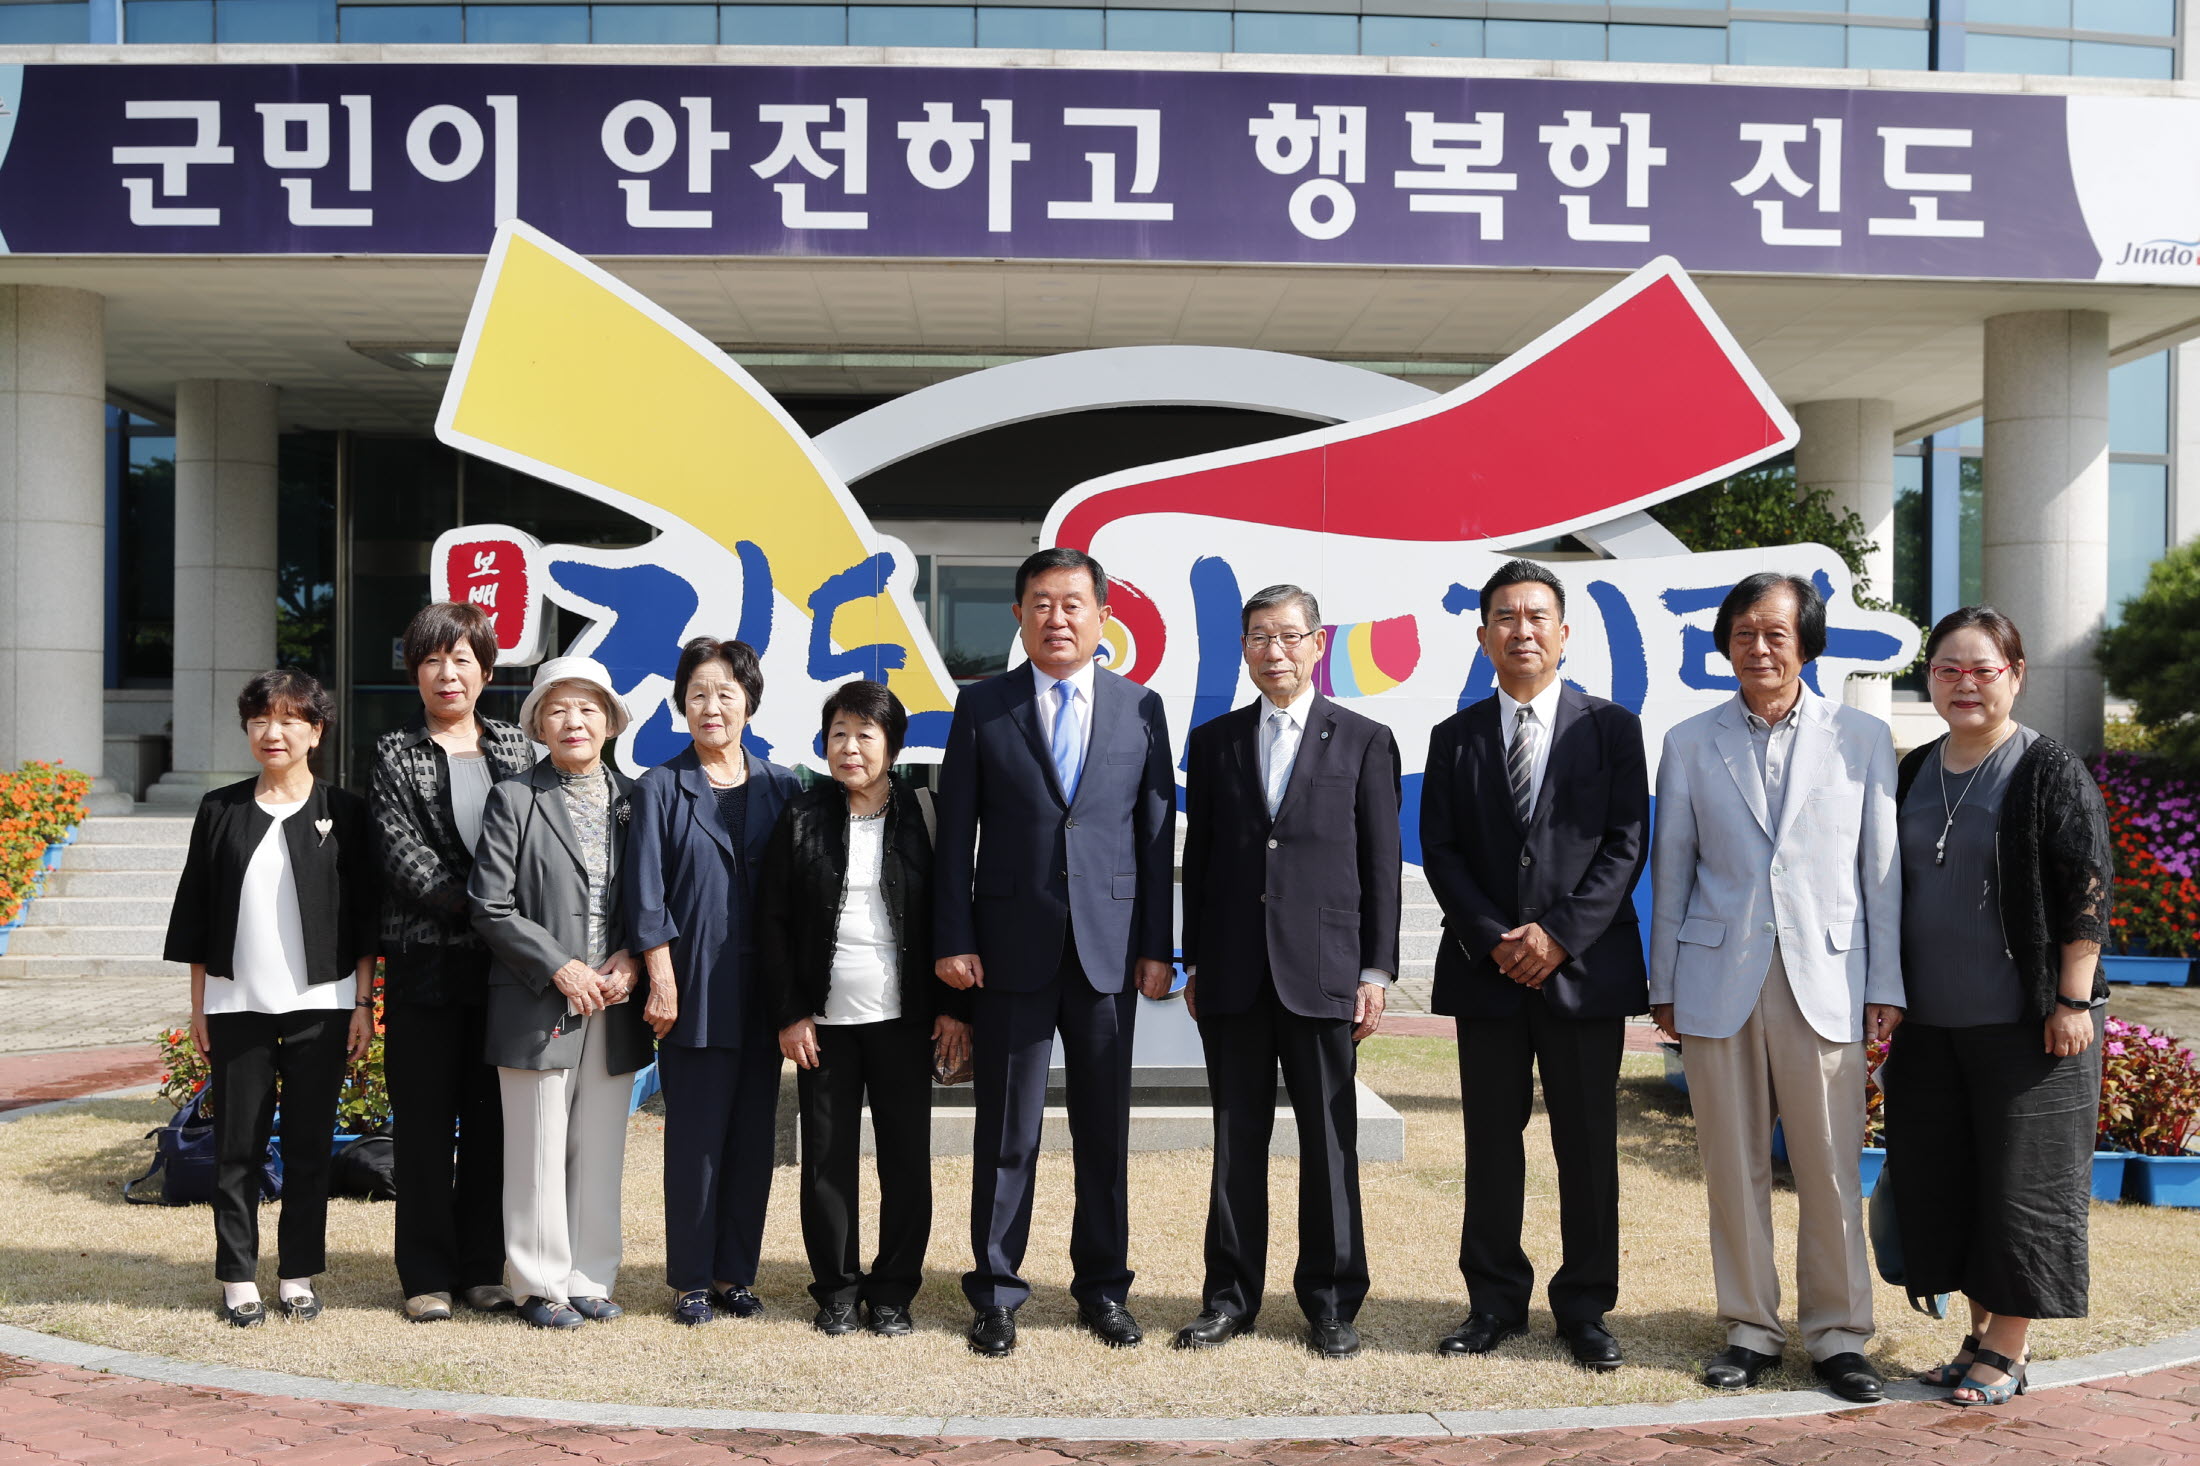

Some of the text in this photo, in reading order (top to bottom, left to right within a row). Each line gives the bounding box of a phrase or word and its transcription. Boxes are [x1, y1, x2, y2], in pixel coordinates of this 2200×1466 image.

[112, 95, 1985, 247] 군민이 안전하고 행복한 진도
[2115, 242, 2193, 266] Jindo
[467, 551, 501, 640] 보배
